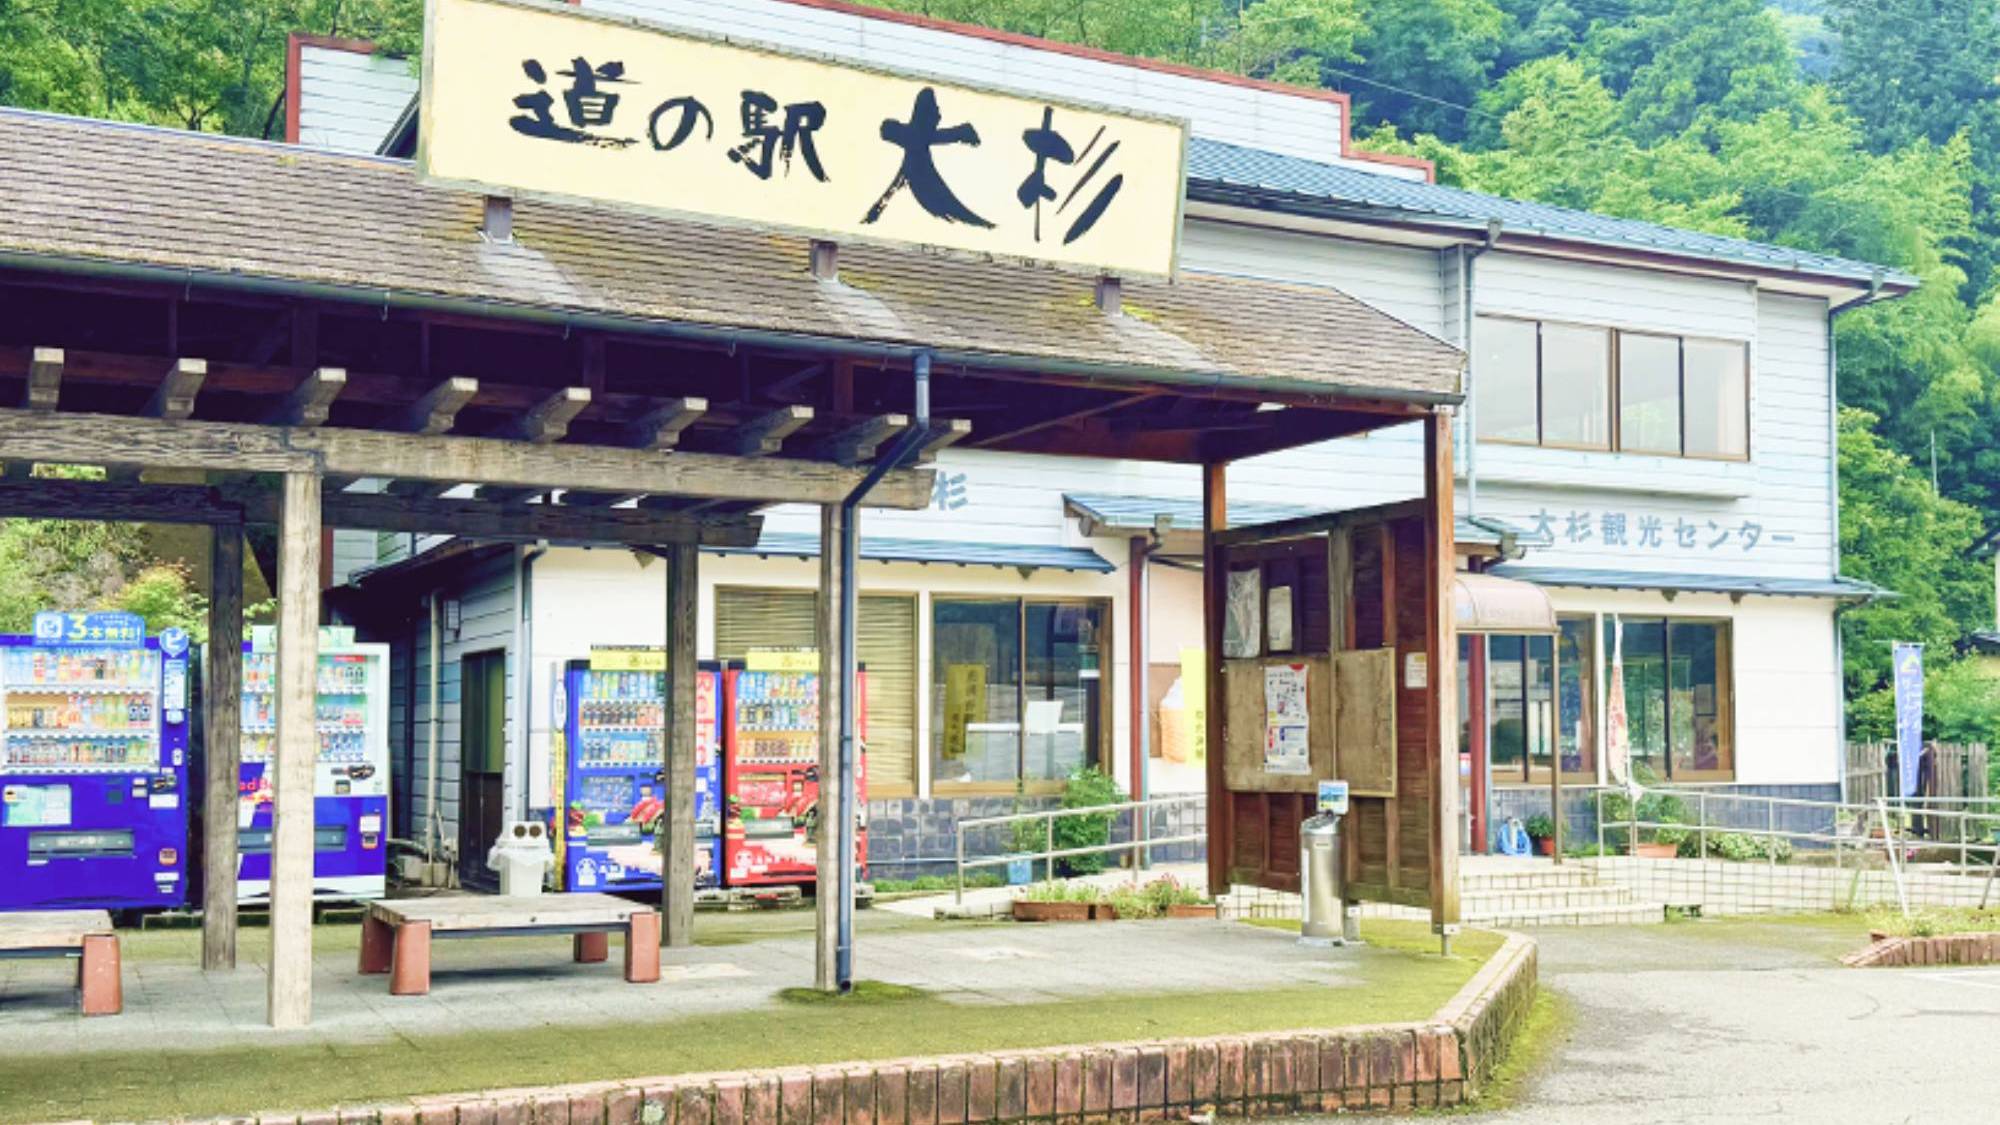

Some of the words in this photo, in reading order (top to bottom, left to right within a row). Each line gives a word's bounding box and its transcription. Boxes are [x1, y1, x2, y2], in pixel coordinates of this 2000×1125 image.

[509, 56, 832, 184] 道の駅
[859, 86, 1124, 246] 大杉
[1529, 508, 1795, 552] 大杉観光センター
